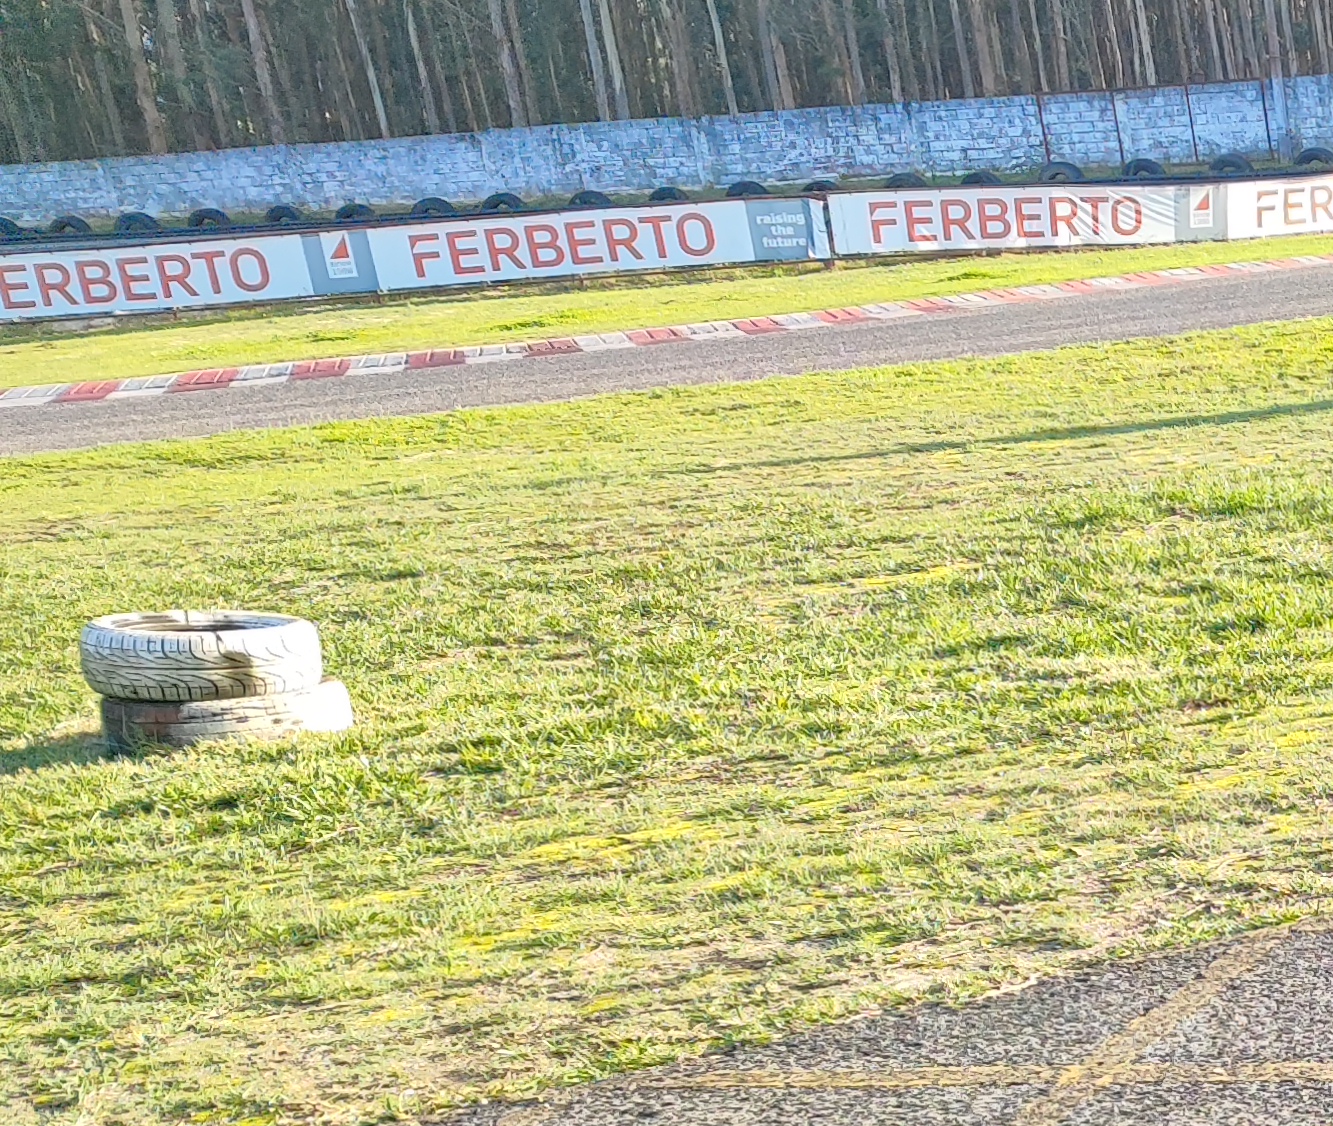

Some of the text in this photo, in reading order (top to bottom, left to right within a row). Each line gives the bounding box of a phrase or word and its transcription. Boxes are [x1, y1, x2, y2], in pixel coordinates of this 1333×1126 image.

[756, 212, 805, 225] raising
[770, 225, 795, 236] the
[868, 195, 1143, 244] FERBERTO
[407, 212, 716, 279] FERBERTO
[762, 236, 807, 248] future
[0, 247, 270, 310] ERBERTO
